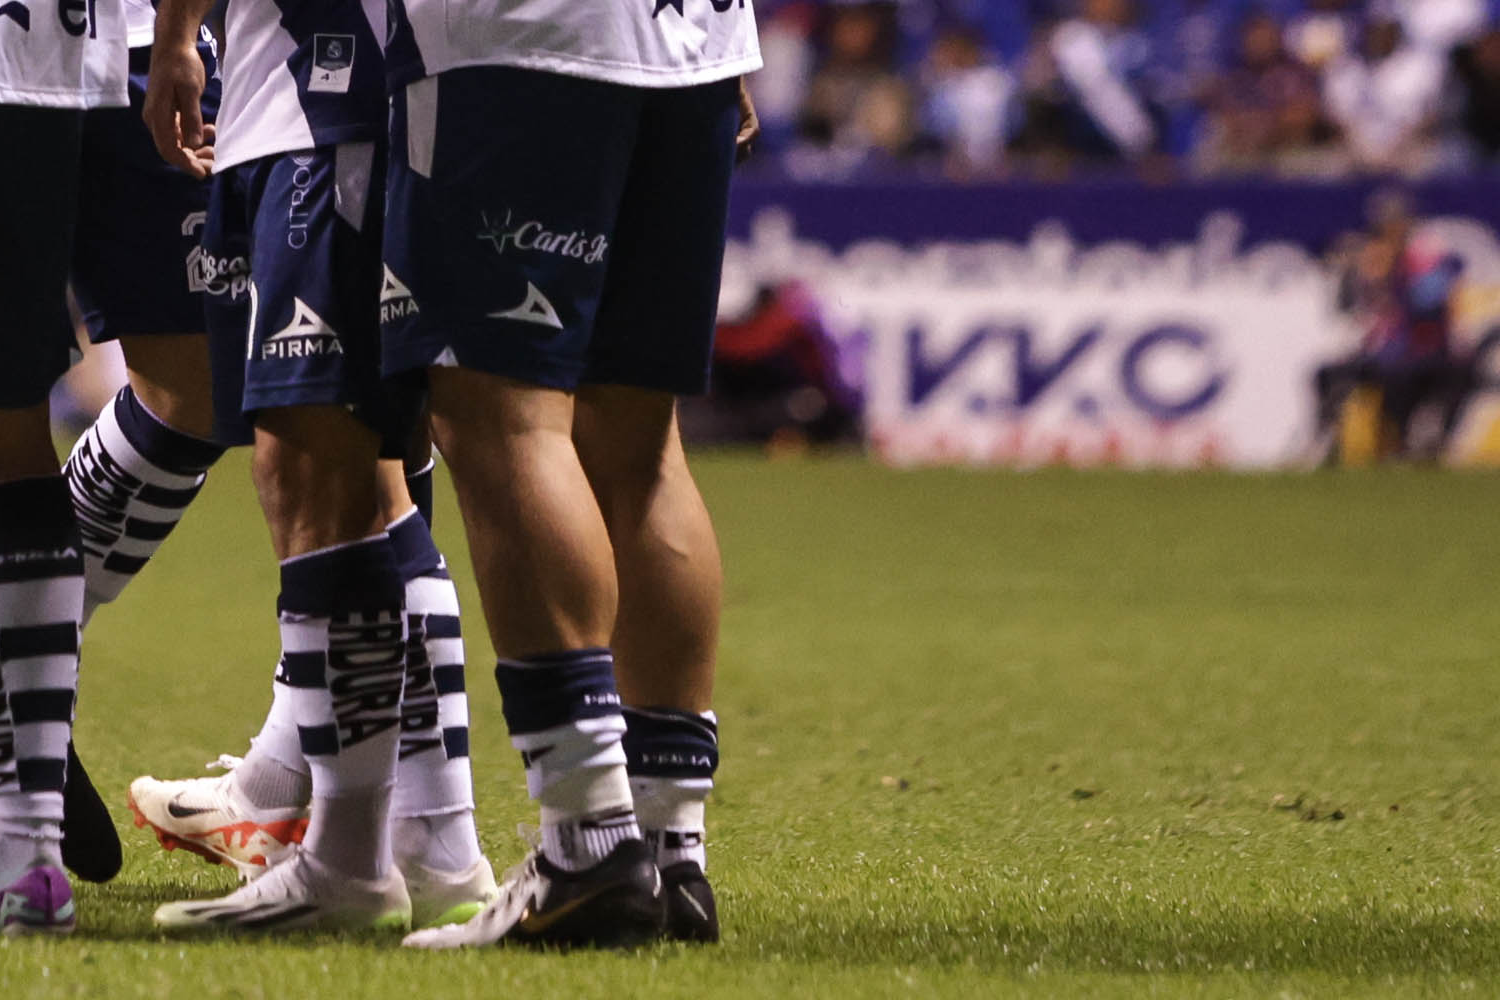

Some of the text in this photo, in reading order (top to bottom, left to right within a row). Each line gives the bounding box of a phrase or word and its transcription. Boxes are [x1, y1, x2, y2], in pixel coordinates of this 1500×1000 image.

[514, 221, 588, 259] Carl's
[380, 299, 420, 324] RMA
[261, 338, 344, 361] PIRMA
